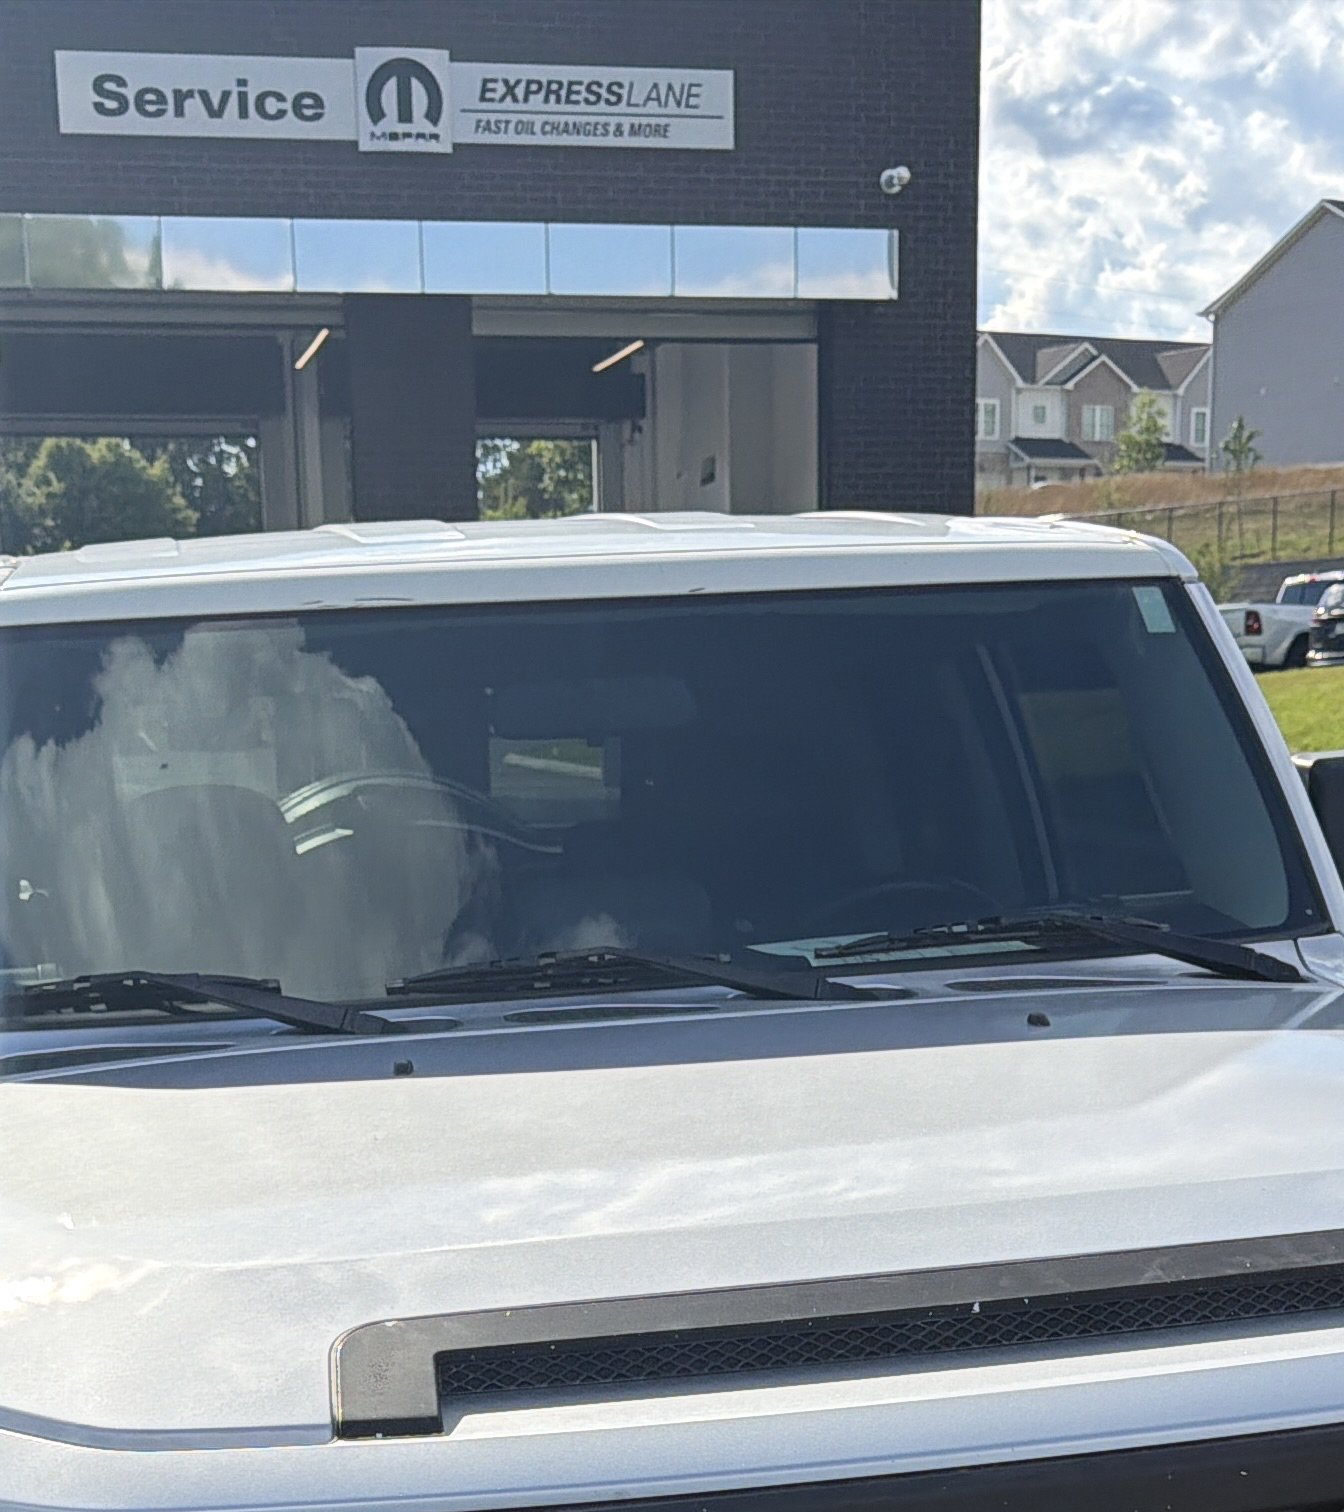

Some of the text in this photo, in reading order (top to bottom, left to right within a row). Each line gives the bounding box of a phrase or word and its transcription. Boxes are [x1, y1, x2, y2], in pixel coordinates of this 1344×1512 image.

[91, 72, 326, 123] Service
[473, 118, 671, 139] FAST OIL CHANGES & MORE
